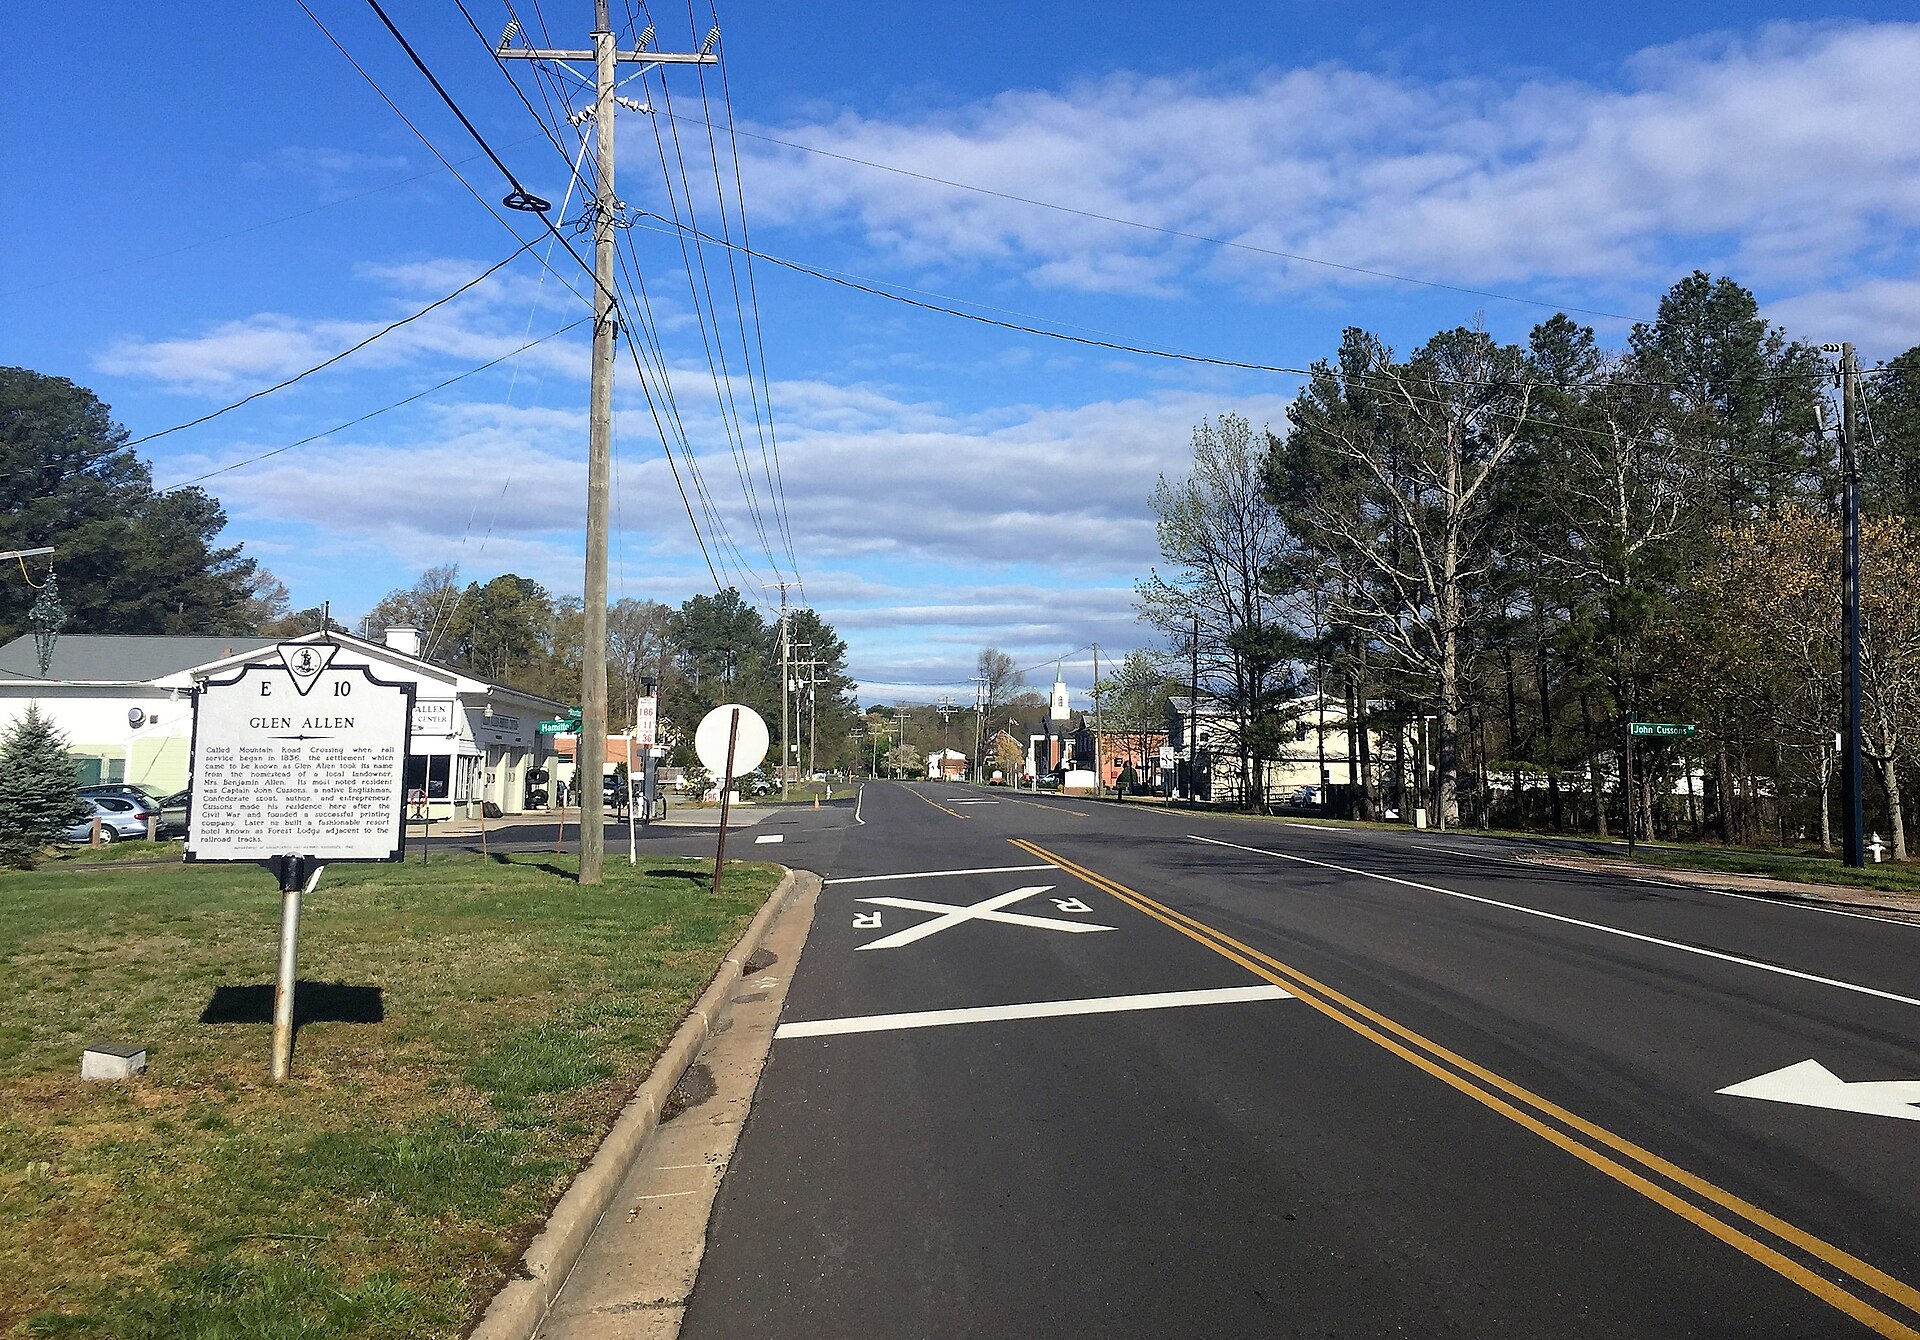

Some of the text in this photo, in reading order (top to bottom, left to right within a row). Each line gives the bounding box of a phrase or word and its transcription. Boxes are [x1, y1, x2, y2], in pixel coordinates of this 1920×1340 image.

[260, 681, 351, 697] E 10
[249, 717, 355, 729] GLEN ALLEN
[1634, 725, 1653, 734] John
[1656, 726, 1687, 735] Cussons
[310, 746, 344, 754] Crossing
[223, 779, 259, 787] Benjamin
[221, 786, 250, 794] Captain
[360, 811, 390, 819] printing
[297, 828, 320, 836] Lodge
[326, 828, 359, 836] adjacent
